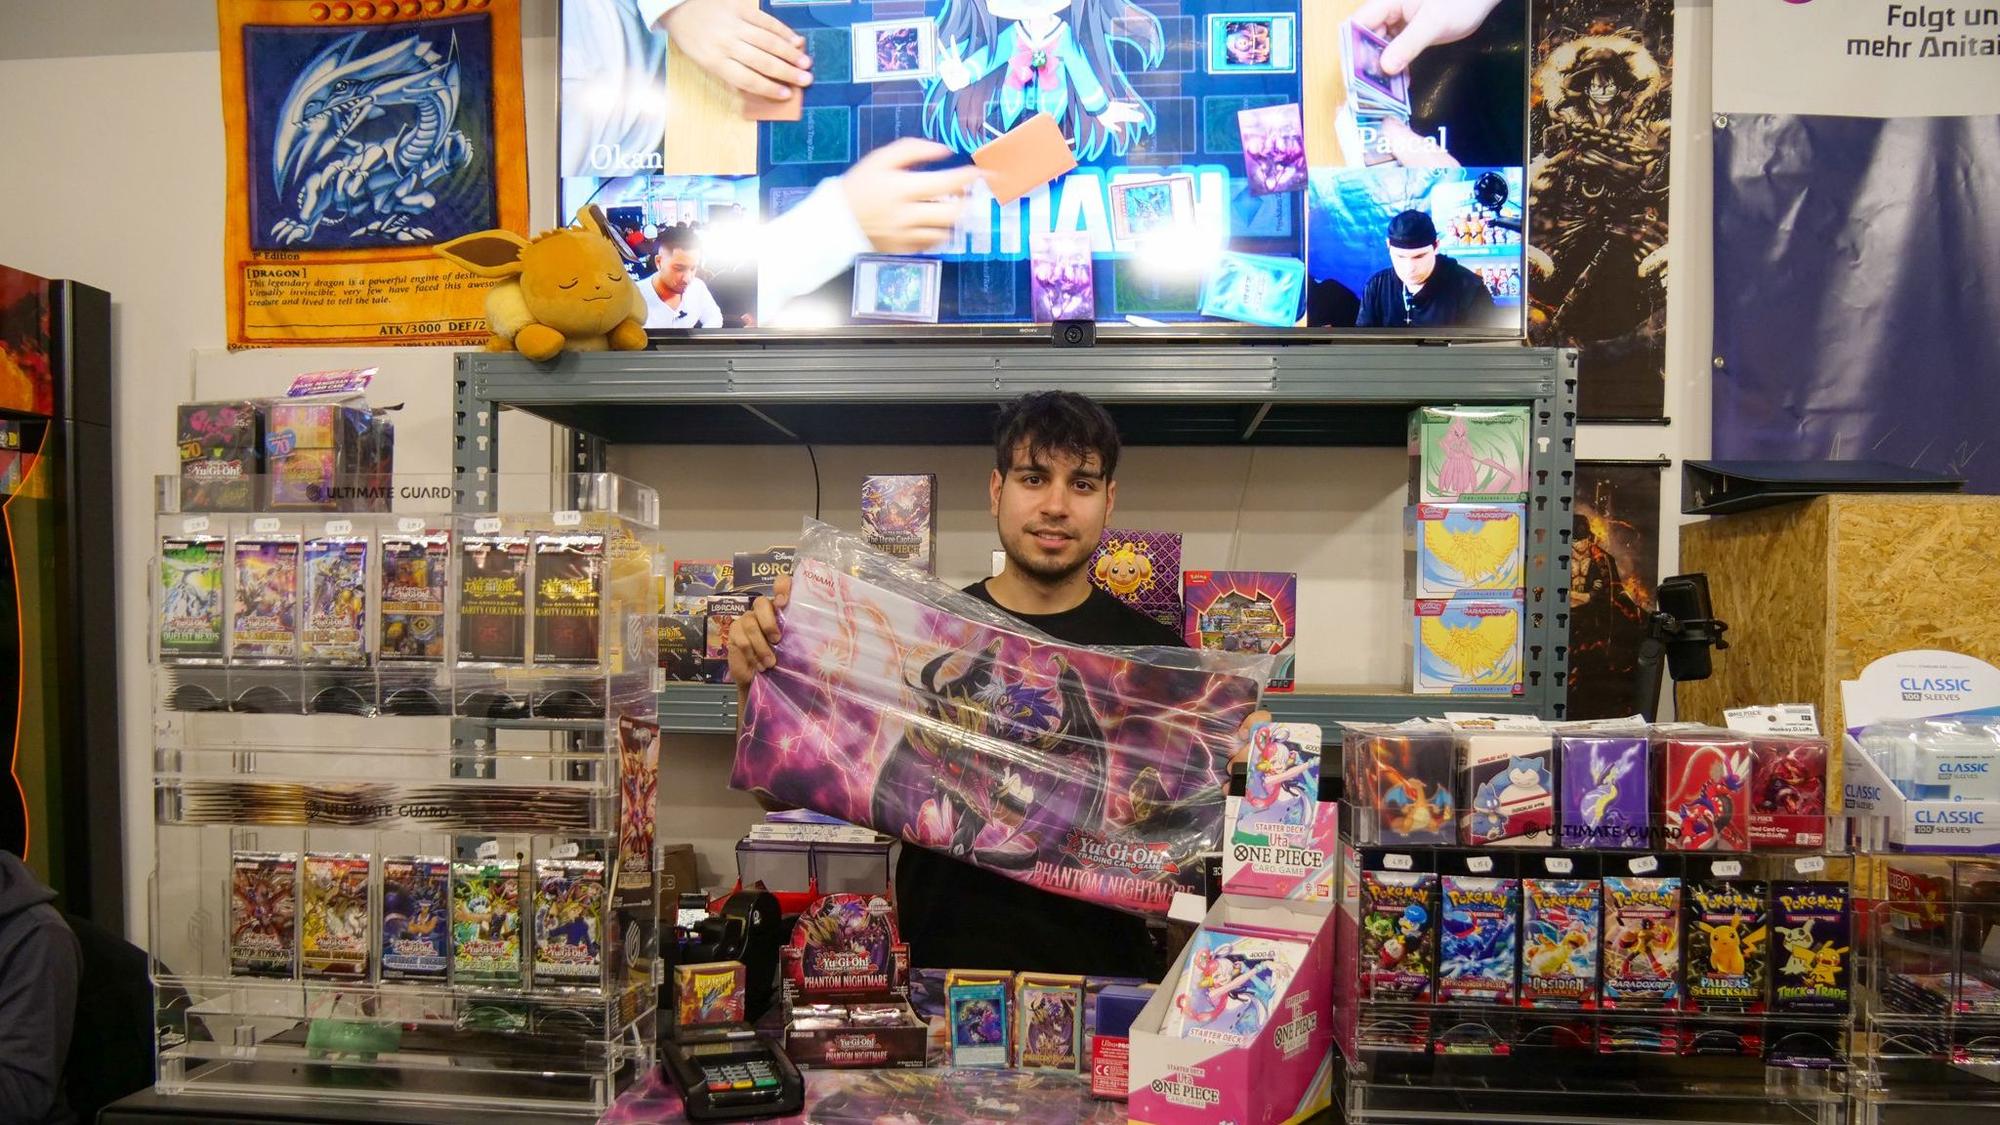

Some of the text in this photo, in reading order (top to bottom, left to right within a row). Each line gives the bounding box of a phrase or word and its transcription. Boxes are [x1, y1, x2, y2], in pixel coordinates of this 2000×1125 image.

[1888, 5, 1999, 33] Folgt un
[1847, 35, 2000, 58] mehr Anitai
[1358, 126, 1448, 153] Pacal
[591, 144, 664, 171] Okan
[264, 252, 300, 260] Edition
[267, 280, 310, 289] legendary
[314, 280, 345, 289] dragon
[369, 276, 407, 289] powerful
[411, 275, 439, 284] engine
[442, 272, 452, 281] of
[367, 287, 383, 296] few
[389, 285, 409, 293] have
[416, 284, 439, 292] faced
[445, 281, 461, 289] this
[467, 280, 495, 289] aweso
[380, 320, 486, 335] ATK/3000 DEF/2
[327, 486, 451, 500] ULTIMATE GUARD
[803, 569, 836, 591] KONAMI
[711, 603, 746, 613] LORCANA
[1900, 677, 1973, 692] CLASSIC
[1923, 693, 1961, 701] SLEEVES
[1938, 762, 1989, 774] CLASSIC
[1845, 784, 1881, 801] CLASSIC
[325, 805, 451, 817] ULTIMATE GUARD
[1915, 810, 1985, 825] CLASSIC
[1255, 824, 1304, 834] STARTER DECK
[1546, 824, 1682, 840] ULTIMATE GUARD
[1936, 826, 1972, 835] SLEEVES
[1269, 833, 1289, 847] Uta
[1079, 837, 1164, 866] Yu-Gi-Oh!
[1234, 845, 1323, 868] ONE PIECE
[1077, 852, 1163, 873] TRADING CARD GAME
[1253, 864, 1304, 874] CARD GAME
[1032, 860, 1104, 892] PHANTOM
[823, 956, 871, 968] Yu-Gi-Oh!
[804, 976, 841, 989] PHANTOM
[843, 974, 888, 987] NIGHTMARE
[1531, 976, 1584, 992] OBSIDIAN
[1607, 979, 1676, 991] PARADOXRIFT
[1701, 976, 1750, 988] PALDEAS
[1690, 985, 1760, 998] SCHICKSALE
[1777, 987, 1806, 1000] TRICK
[1815, 985, 1848, 1000] TRADE
[1294, 1013, 1317, 1036] PIECE
[840, 1038, 876, 1047] Yu-Gi-Oh!
[1190, 1029, 1242, 1043] STARTER DECK
[854, 1051, 888, 1061] NIGHTMARE
[1176, 1072, 1194, 1084] Uta
[1182, 1086, 1220, 1103] PIECE
